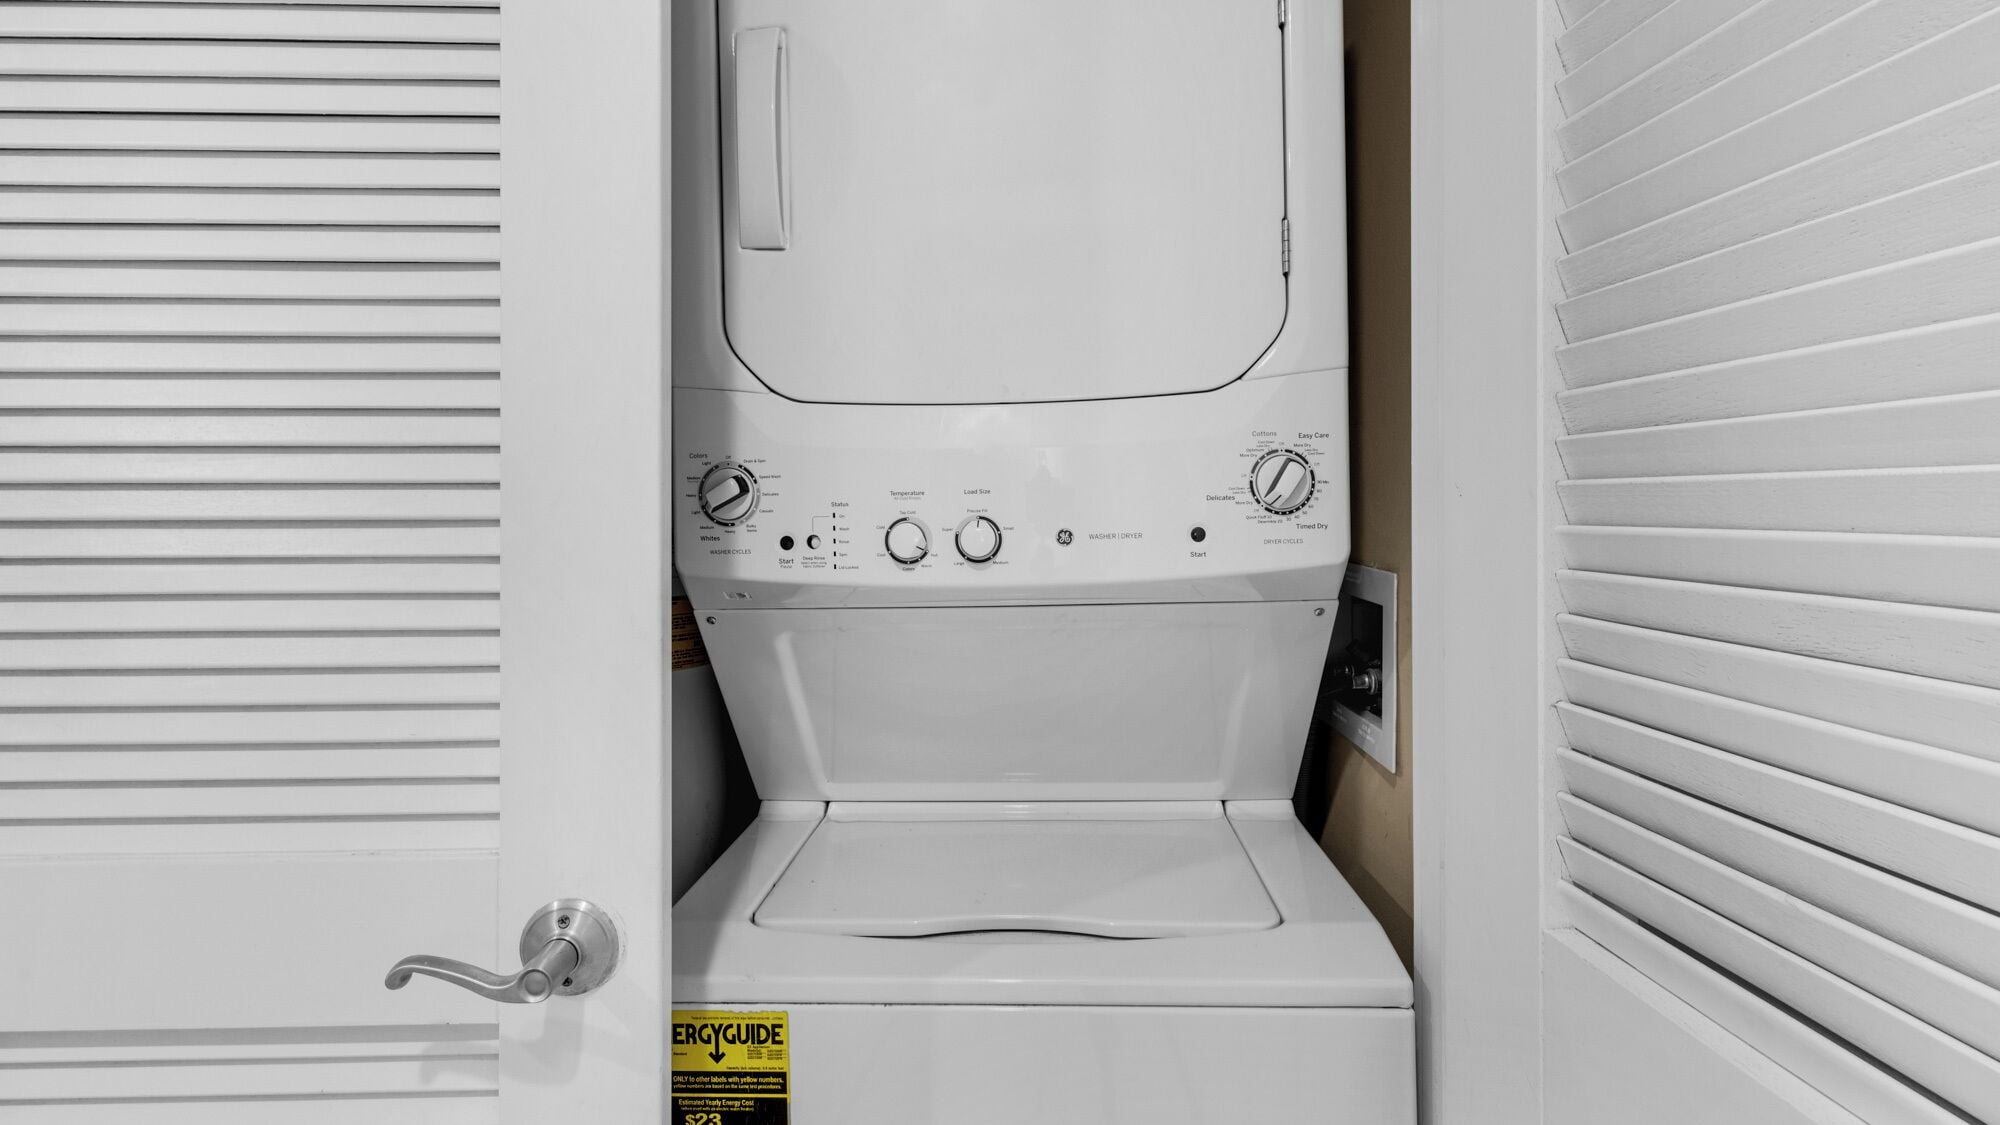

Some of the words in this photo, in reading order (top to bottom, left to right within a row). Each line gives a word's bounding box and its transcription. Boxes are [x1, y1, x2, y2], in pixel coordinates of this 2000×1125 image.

[672, 1023, 784, 1045] ERGYGUIDE
[740, 1076, 758, 1084] yellow
[706, 1099, 721, 1107] Yearly
[722, 1099, 741, 1107] Energy
[685, 1113, 722, 1125] $23
